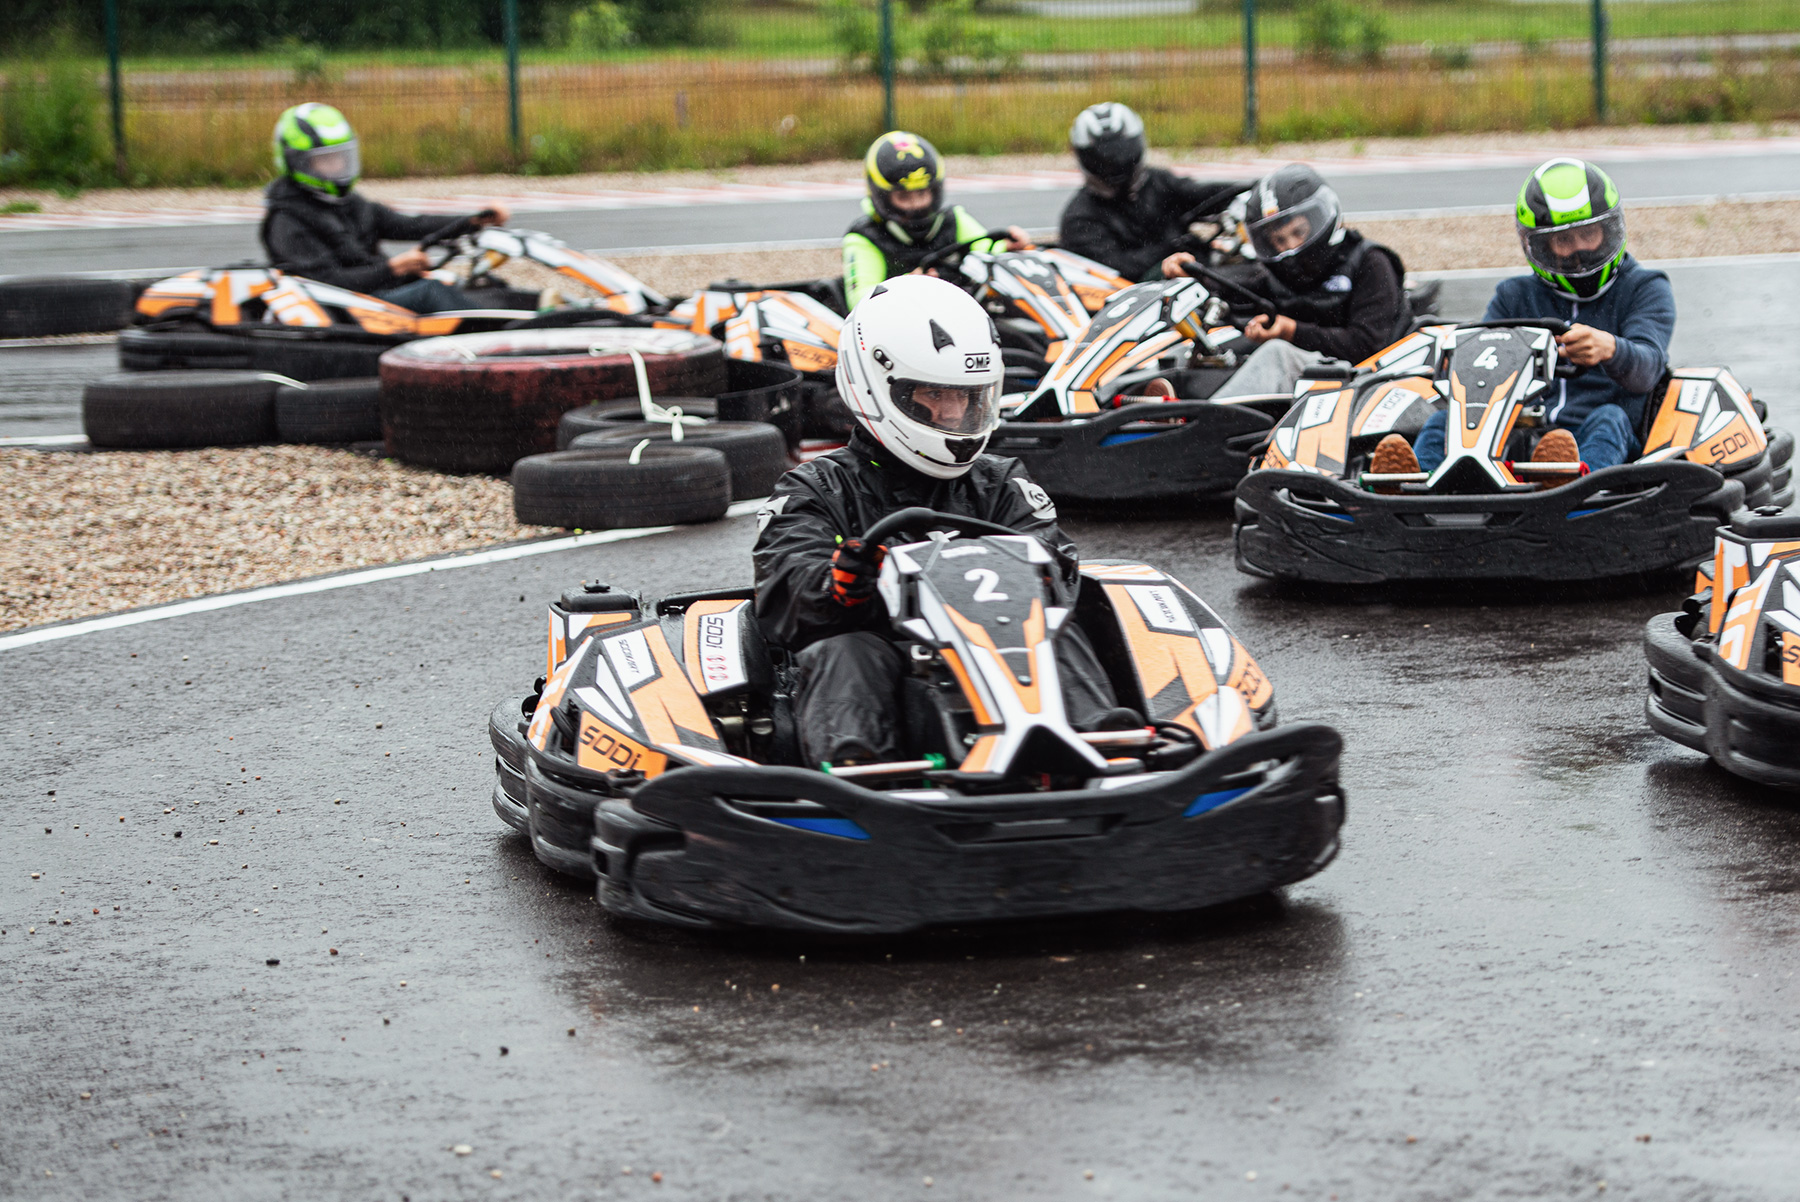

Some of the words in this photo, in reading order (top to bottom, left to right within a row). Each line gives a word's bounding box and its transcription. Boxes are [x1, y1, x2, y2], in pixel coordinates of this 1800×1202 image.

[964, 357, 990, 369] OMP
[1473, 346, 1499, 370] 4
[1709, 429, 1752, 462] SODI
[964, 568, 1009, 602] 2
[706, 616, 724, 649] SODI
